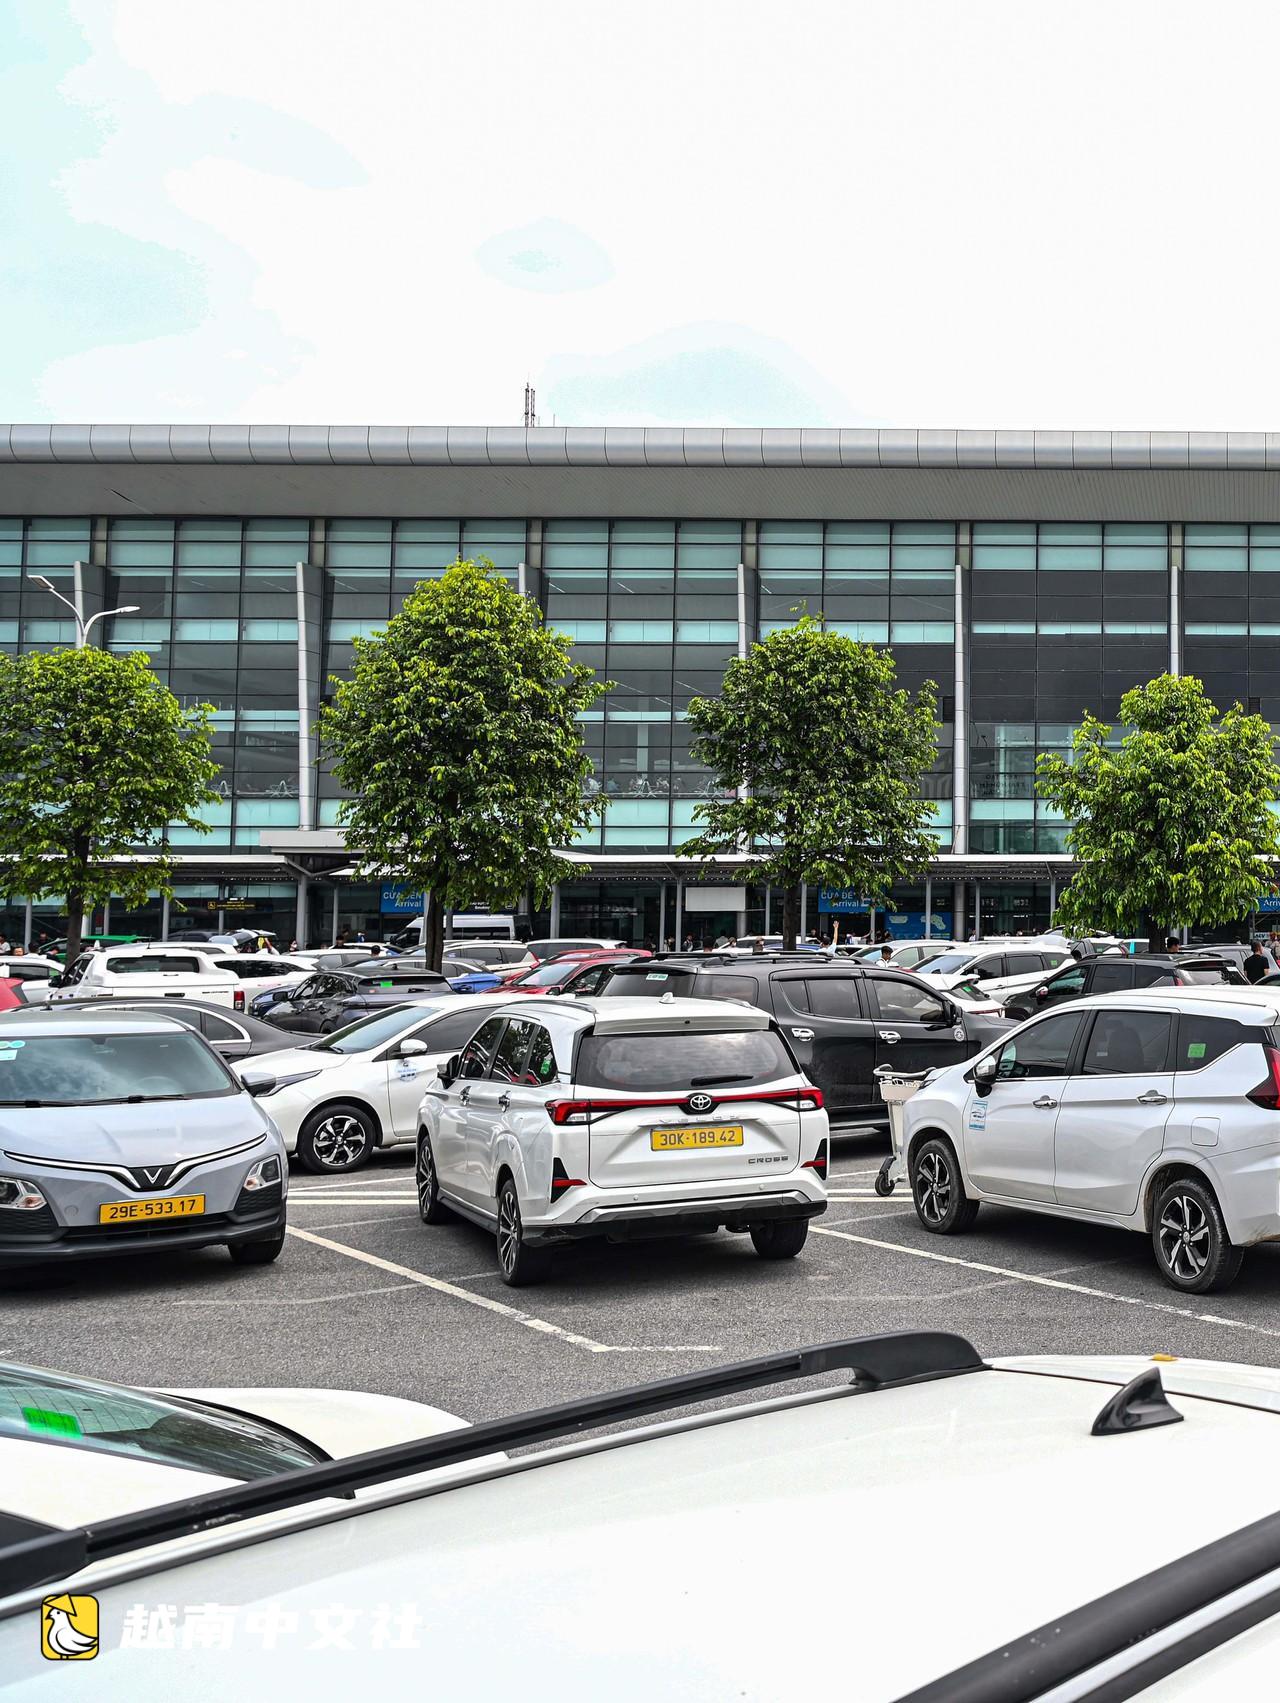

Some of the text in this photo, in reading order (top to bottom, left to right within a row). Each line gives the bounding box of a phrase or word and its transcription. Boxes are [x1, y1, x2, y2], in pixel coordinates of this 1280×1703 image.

[660, 1129, 737, 1147] 30K-189.42
[748, 1155, 789, 1165] CROSS
[109, 1198, 197, 1220] 29E-533.17
